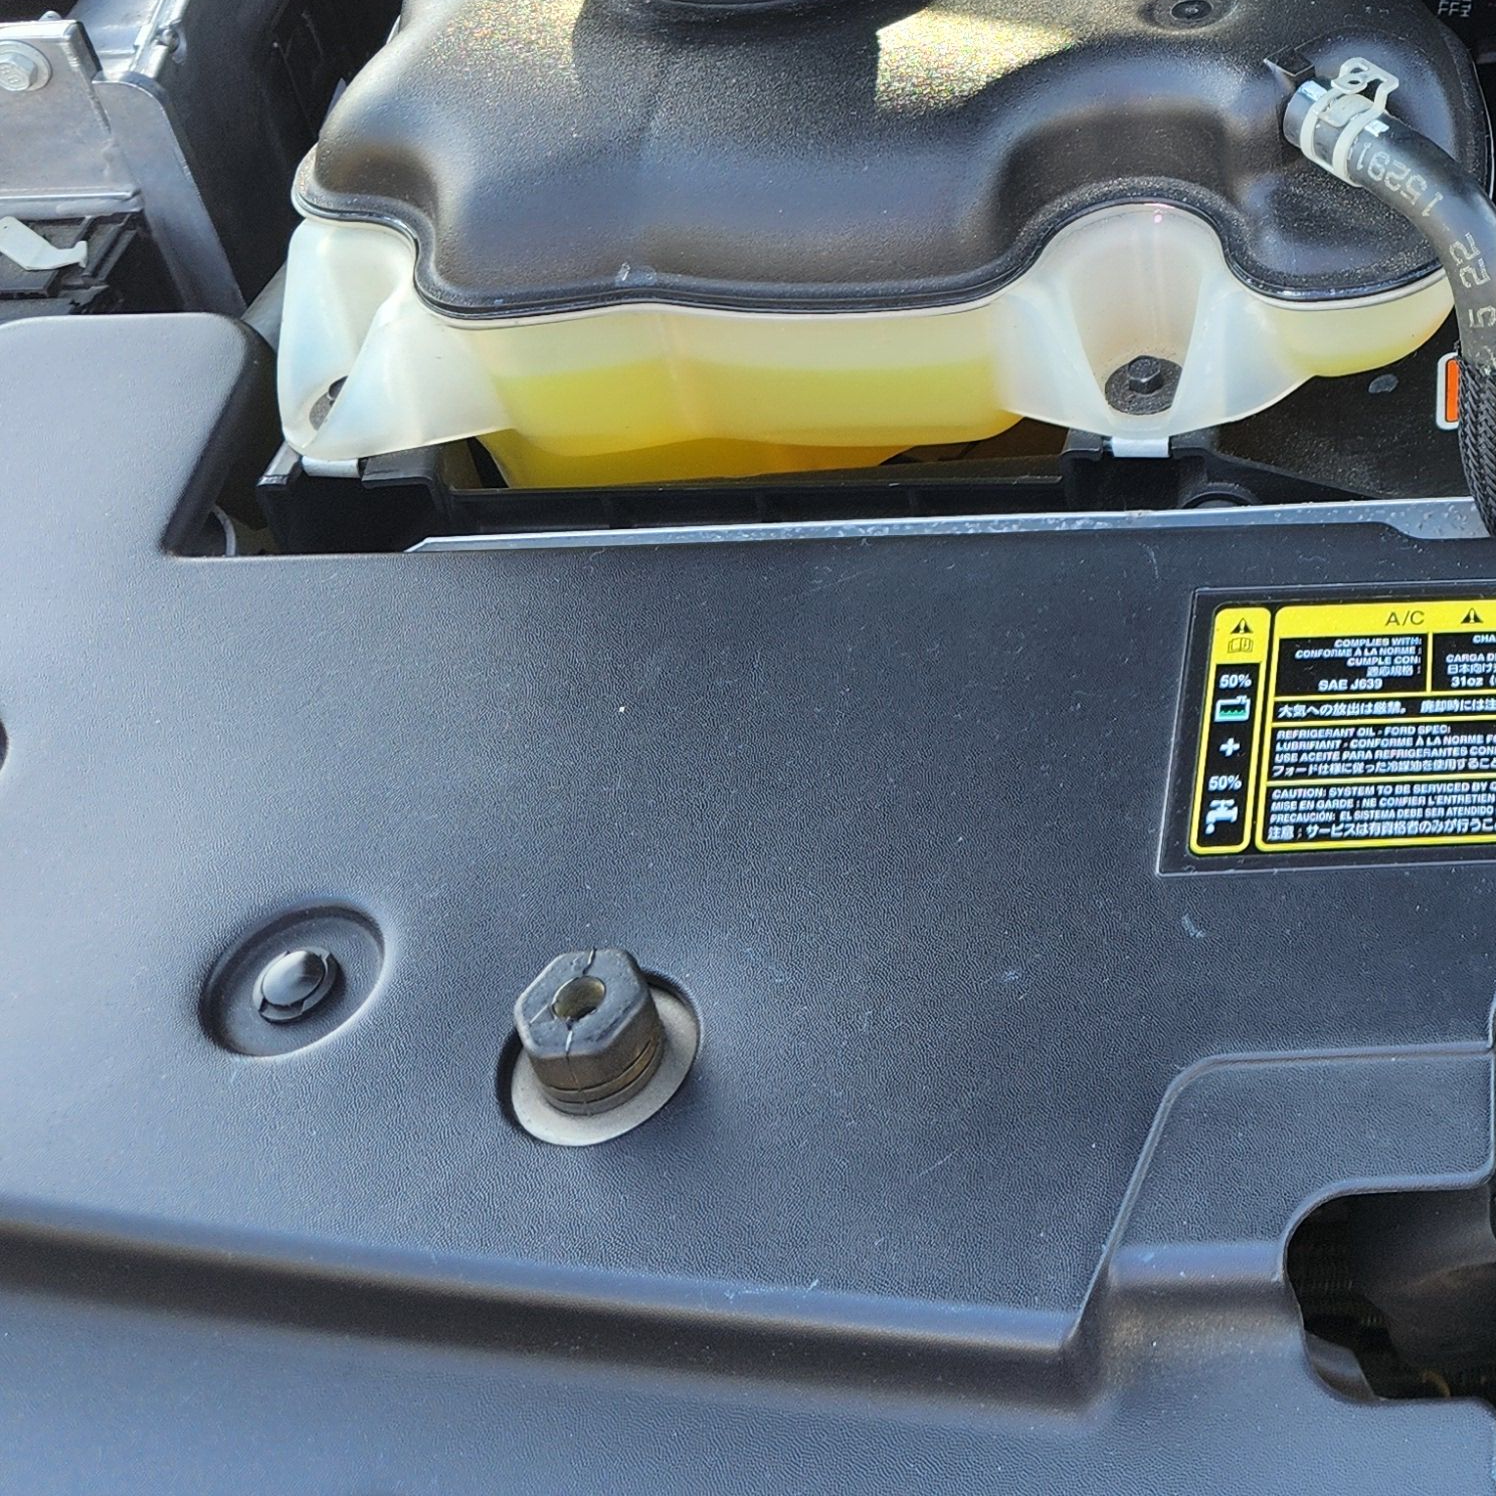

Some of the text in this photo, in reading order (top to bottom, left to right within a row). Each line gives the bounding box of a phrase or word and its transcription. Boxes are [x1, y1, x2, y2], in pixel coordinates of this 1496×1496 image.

[1385, 610, 1425, 626] A/C
[1446, 653, 1484, 663] CARGA
[1219, 673, 1251, 689] 50%
[1318, 677, 1383, 692] SAE J639
[1451, 676, 1483, 687] 31oz
[1276, 724, 1451, 740] REFRIGERANT OIL FORD SPEC:
[1274, 753, 1298, 763] USE
[1299, 751, 1340, 762] ACEITE
[1342, 750, 1373, 760] PARA
[1374, 746, 1468, 759] REFRIGERANTES
[1209, 775, 1242, 791] 50%
[1271, 788, 1327, 800] CAUTION:
[1329, 786, 1375, 797] SYSTEM
[1376, 785, 1393, 796] TO
[1395, 785, 1411, 795] BE
[1413, 783, 1470, 794] SERVICED
[1471, 781, 1488, 792] BY
[1271, 801, 1298, 812] MISE
[1299, 800, 1315, 811] EN
[1316, 799, 1354, 810] GARDE
[1362, 798, 1377, 808] NE
[1379, 796, 1426, 807] CONFIER
[1269, 811, 1336, 824] PRECAUCIÓN:
[1339, 810, 1352, 820] EL
[1354, 809, 1395, 820] SISTEMA
[1397, 808, 1423, 819] DEBE
[1424, 807, 1445, 818] SER
[1446, 805, 1494, 817] ATENDIDO
